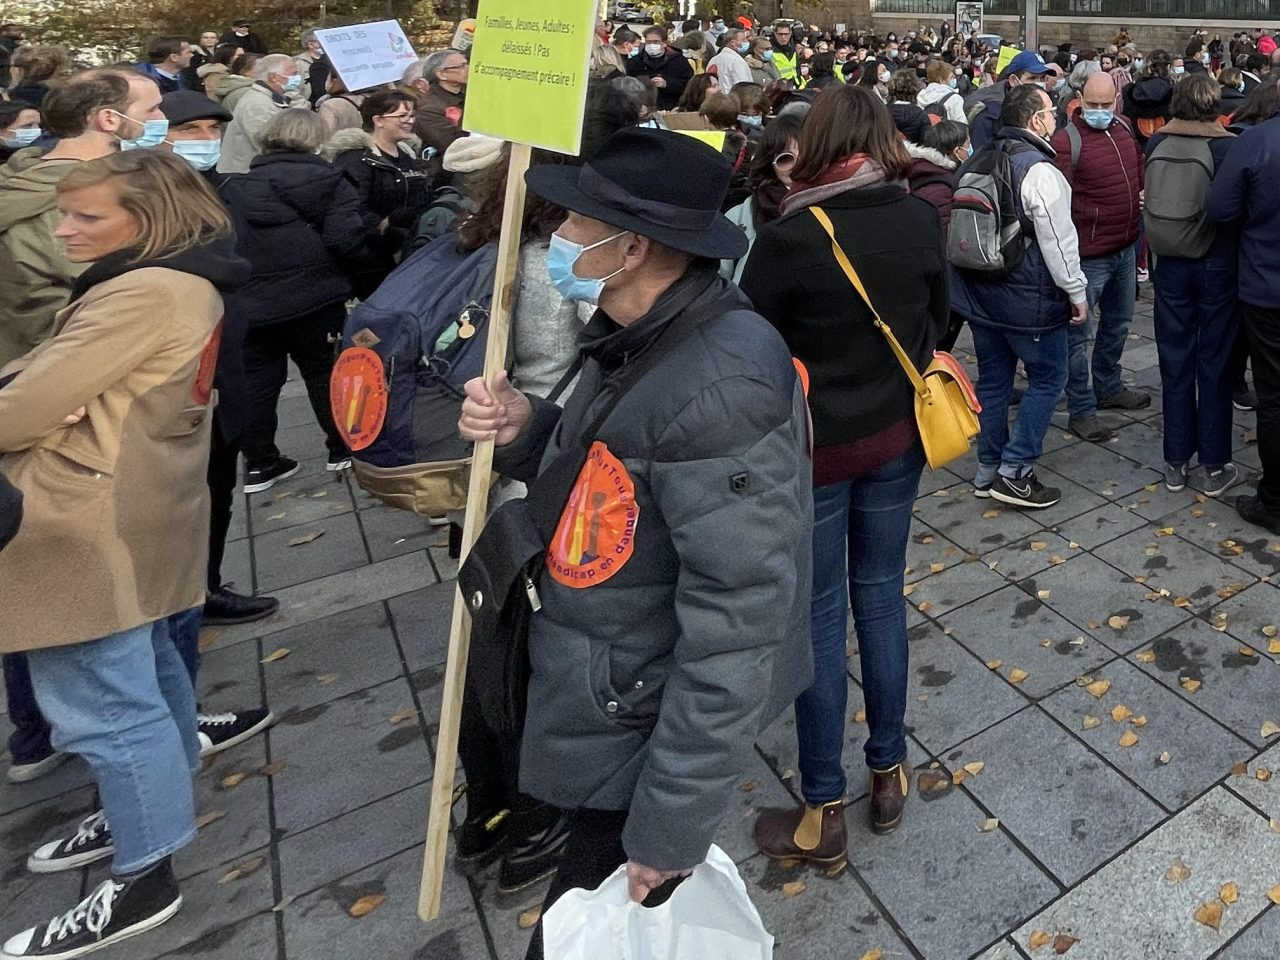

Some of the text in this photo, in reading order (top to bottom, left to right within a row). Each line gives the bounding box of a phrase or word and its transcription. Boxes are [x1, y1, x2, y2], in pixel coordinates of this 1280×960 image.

[485, 15, 514, 32] Familles,
[515, 17, 540, 34] Jeunes,
[542, 19, 570, 34] Adultes
[501, 40, 532, 56] délaissés
[537, 44, 550, 58] Pas
[539, 70, 570, 86] précaire
[600, 556, 614, 570] en
